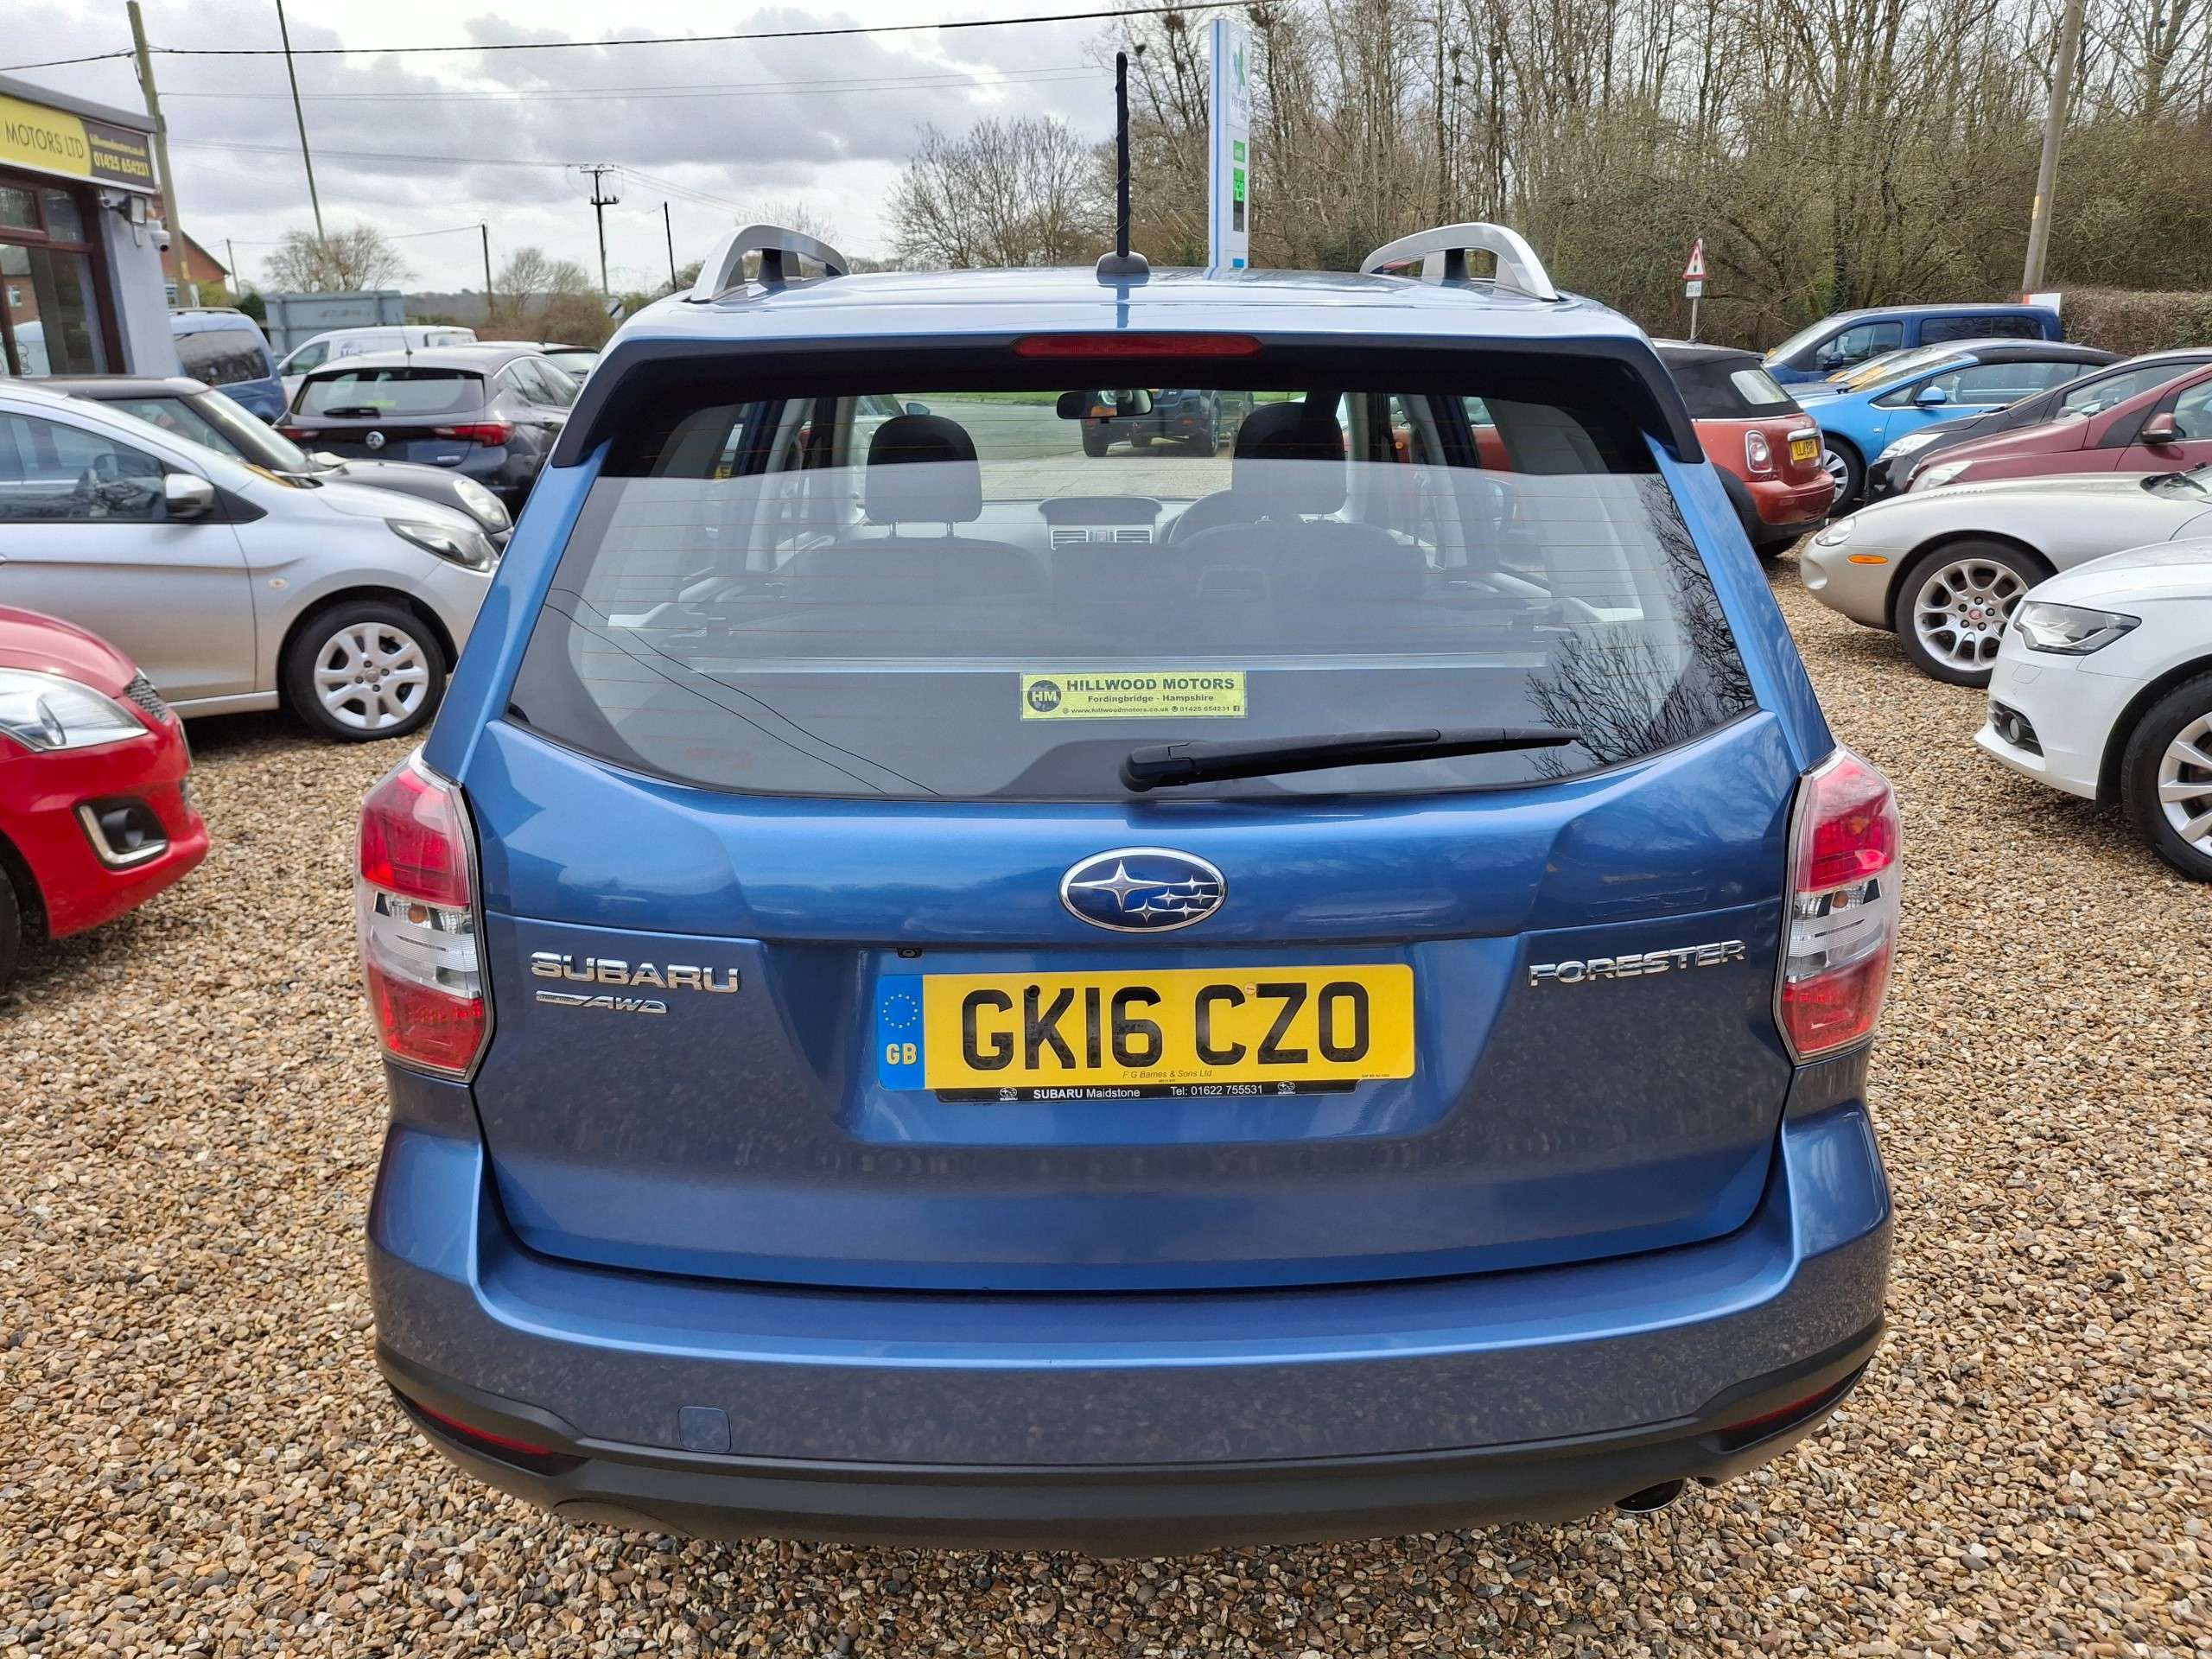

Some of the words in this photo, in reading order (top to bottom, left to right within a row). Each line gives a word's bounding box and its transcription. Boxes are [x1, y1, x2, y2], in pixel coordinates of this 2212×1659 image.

[5, 119, 63, 155] MOTORS
[64, 135, 84, 159] LTD
[1066, 678, 1157, 691] HILLWOOD
[1162, 677, 1235, 690] MOTORS
[1031, 690, 1058, 702] HM
[1088, 695, 1154, 703] Fordingbridge
[1162, 694, 1214, 702] Hampshire
[1528, 938, 1747, 988] FORESTER
[530, 950, 741, 994] SUBARU
[580, 995, 669, 1014] AWD
[961, 986, 1163, 1071] GK16
[1194, 981, 1370, 1067] CZO
[886, 1042, 918, 1065] GB
[1199, 1069, 1212, 1077] Ltd
[1033, 1089, 1084, 1100] SUBARU
[1086, 1088, 1141, 1099] Maidstone
[1170, 1086, 1188, 1096] Tel:
[1191, 1085, 1223, 1096] 01622
[1226, 1084, 1263, 1095] 755531
